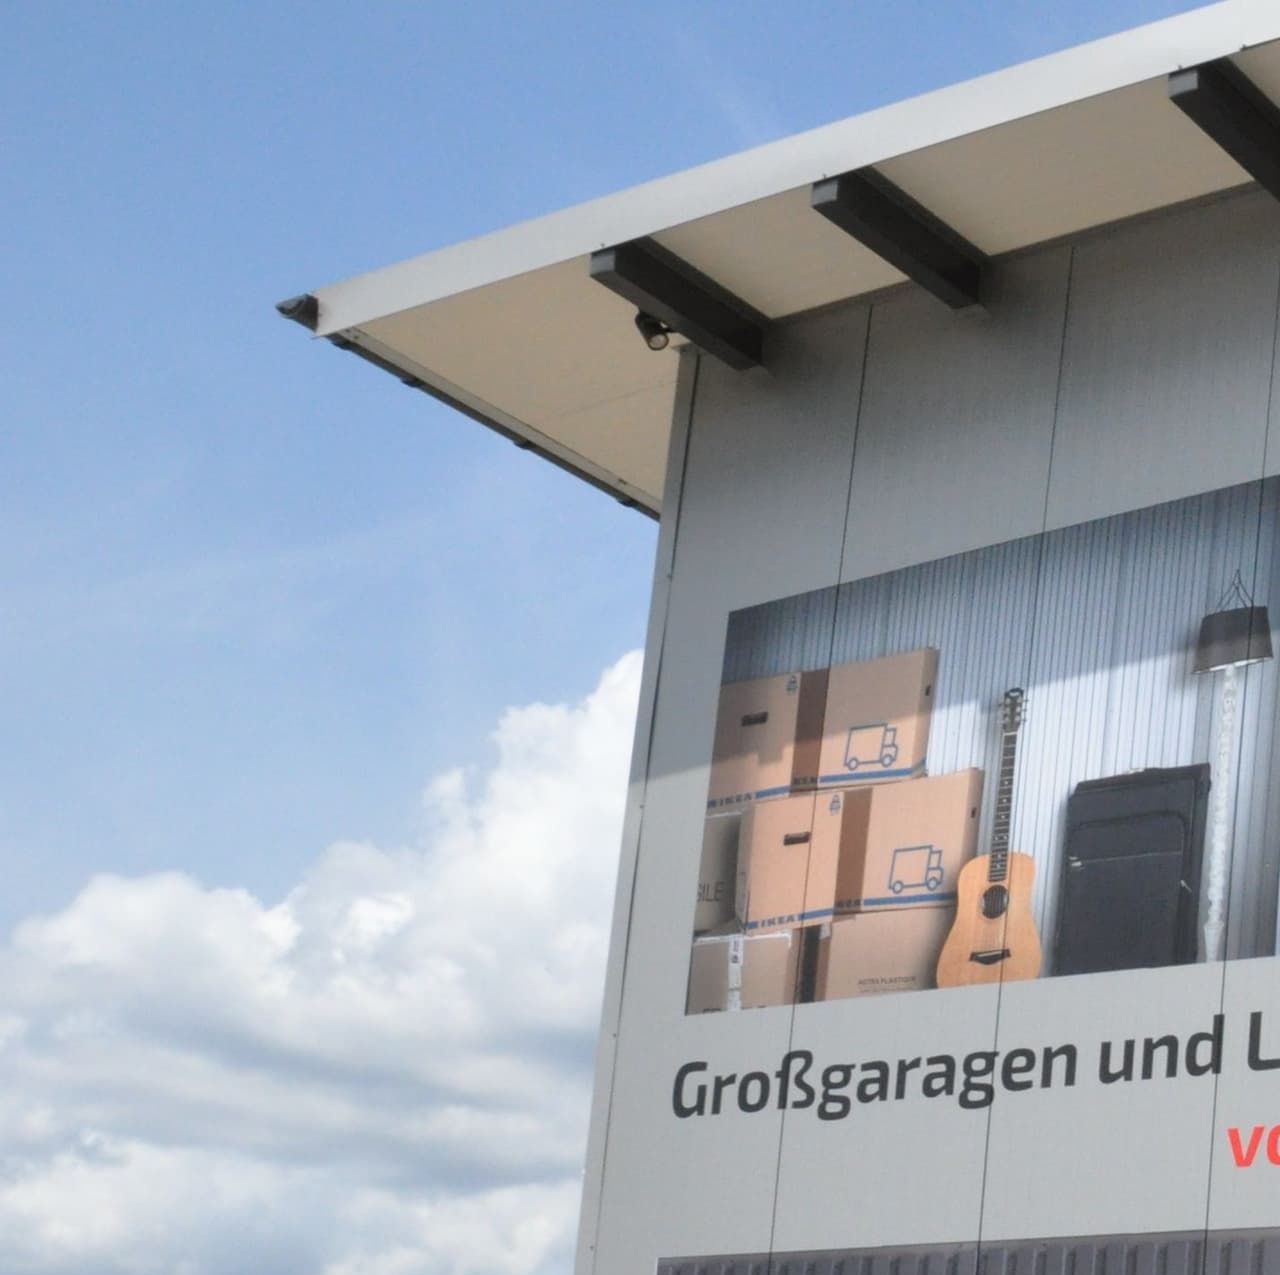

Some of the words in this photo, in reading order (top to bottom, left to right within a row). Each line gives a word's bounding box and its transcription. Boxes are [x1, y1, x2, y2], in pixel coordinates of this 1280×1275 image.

[761, 914, 796, 928] IKEA
[671, 1049, 1078, 1121] Großgaragen
[1098, 1013, 1225, 1085] und
